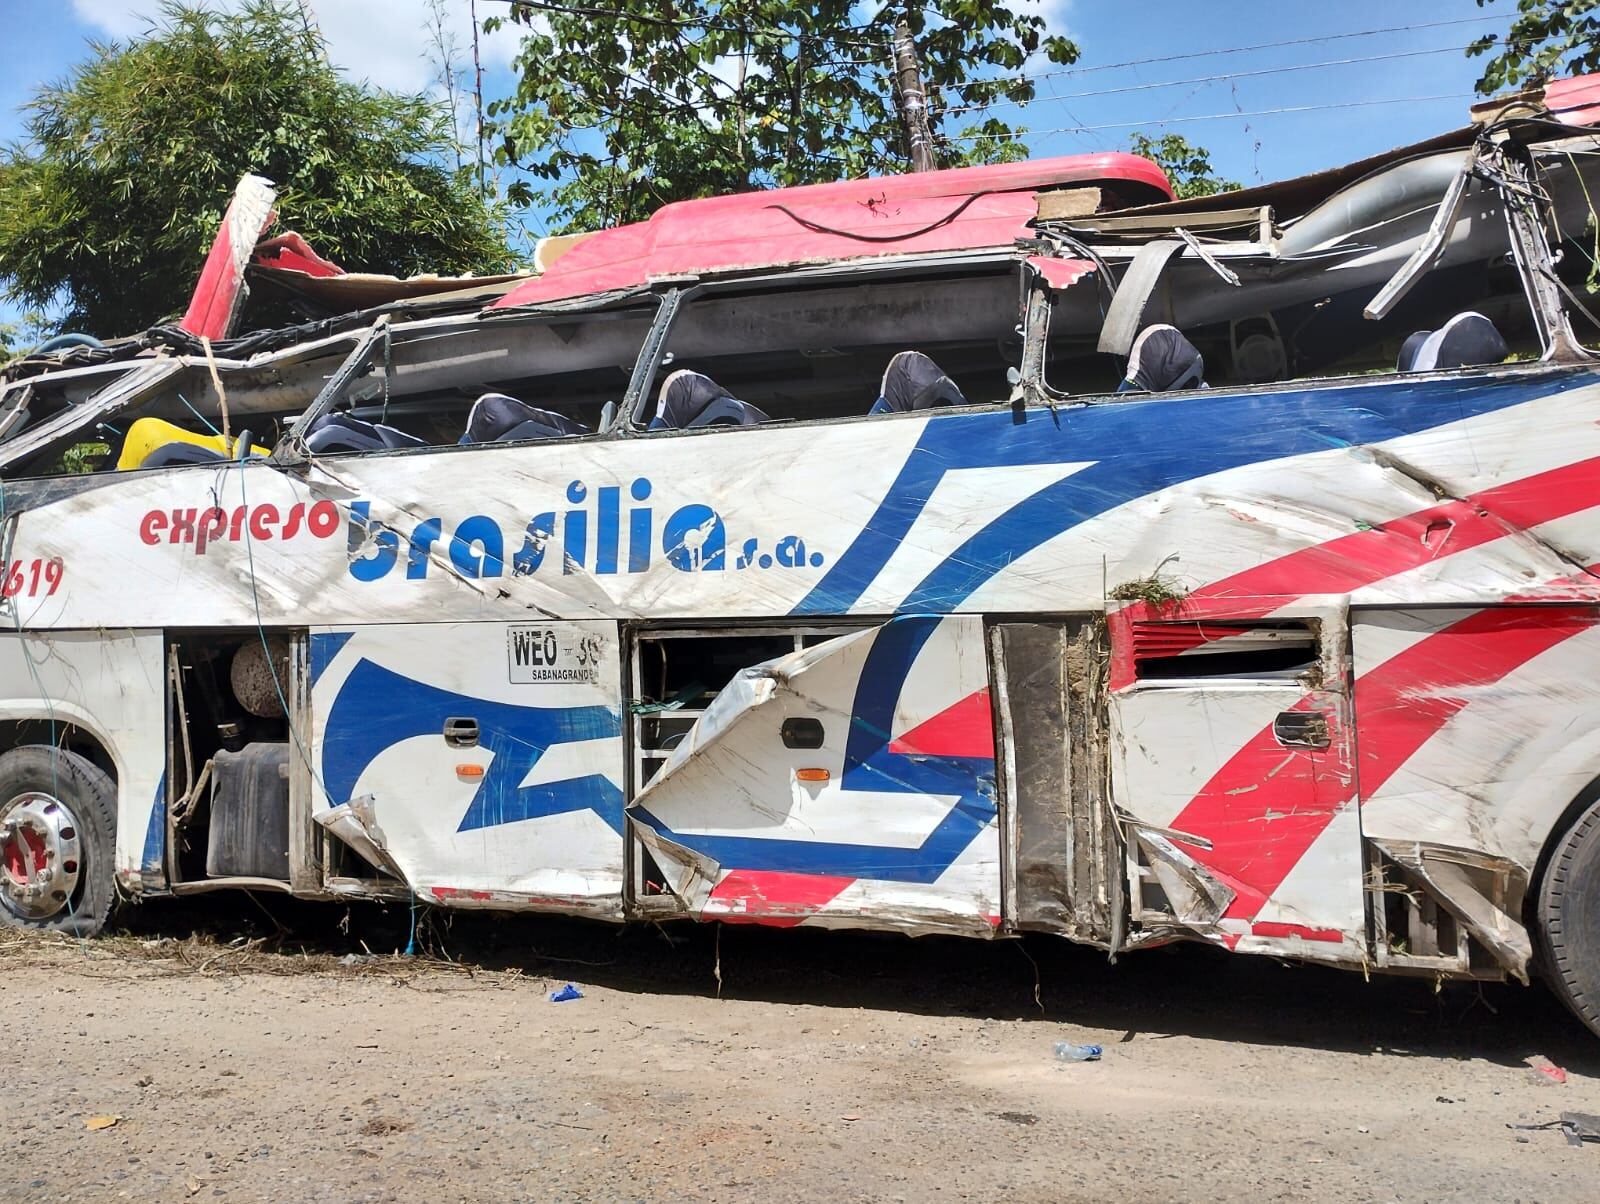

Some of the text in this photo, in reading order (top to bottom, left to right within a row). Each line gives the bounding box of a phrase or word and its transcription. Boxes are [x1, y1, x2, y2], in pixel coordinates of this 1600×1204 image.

[139, 477, 824, 582] expreso brasilia s.a.
